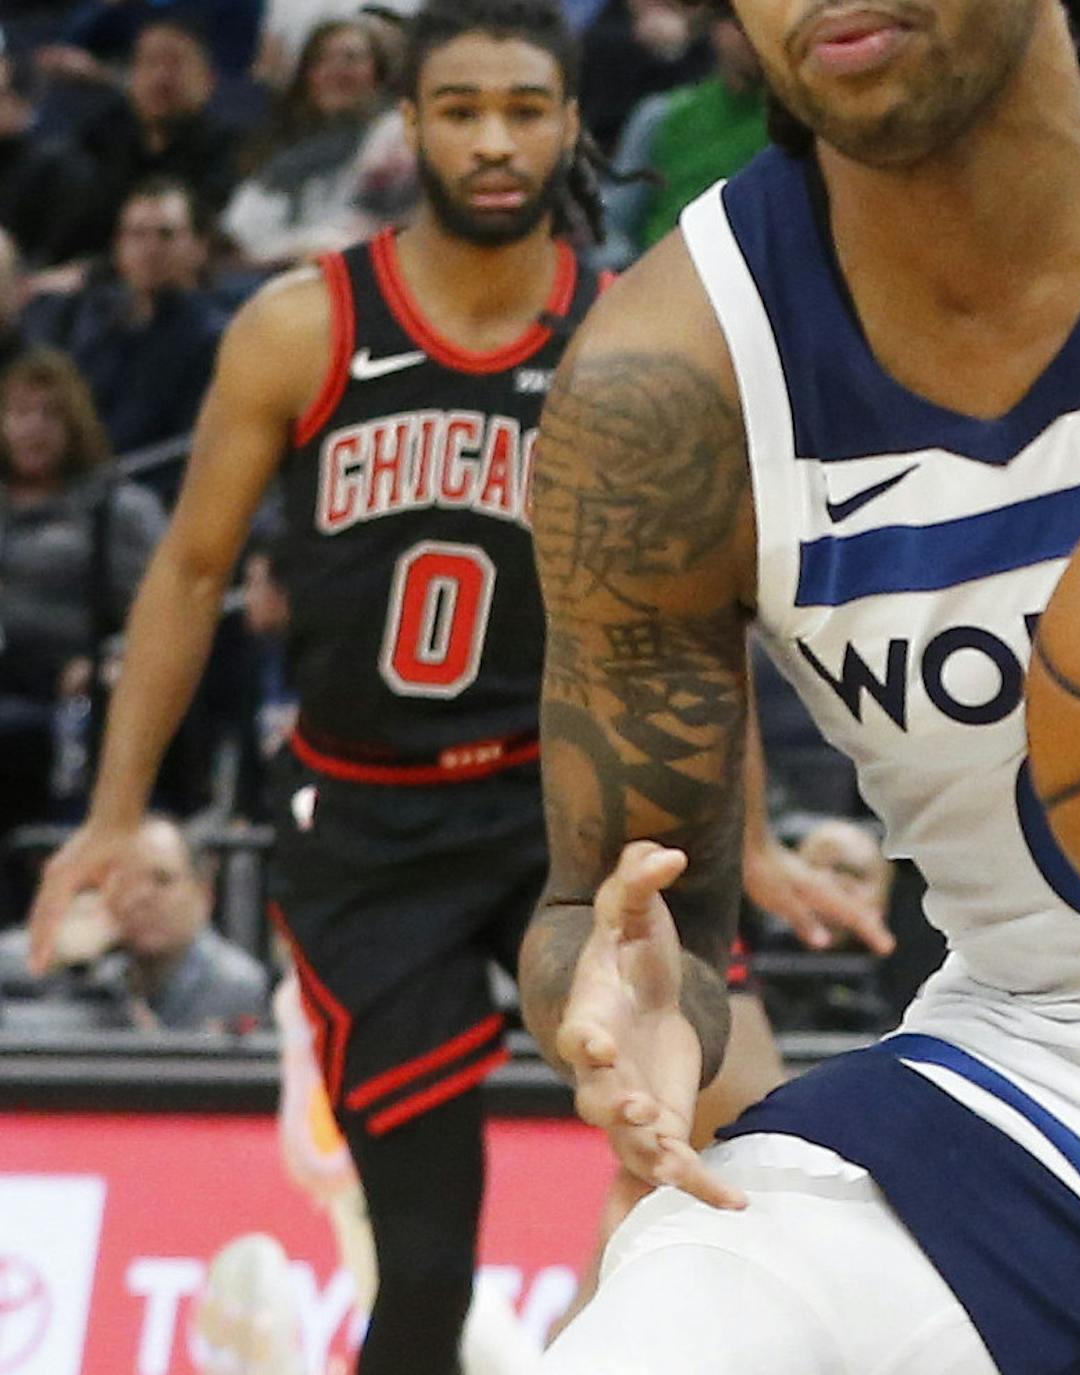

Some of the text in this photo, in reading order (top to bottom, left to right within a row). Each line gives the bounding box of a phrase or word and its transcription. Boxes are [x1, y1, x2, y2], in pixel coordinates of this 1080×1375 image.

[315, 409, 541, 536] CHICA
[378, 540, 497, 700] 0
[795, 612, 1042, 734] WO
